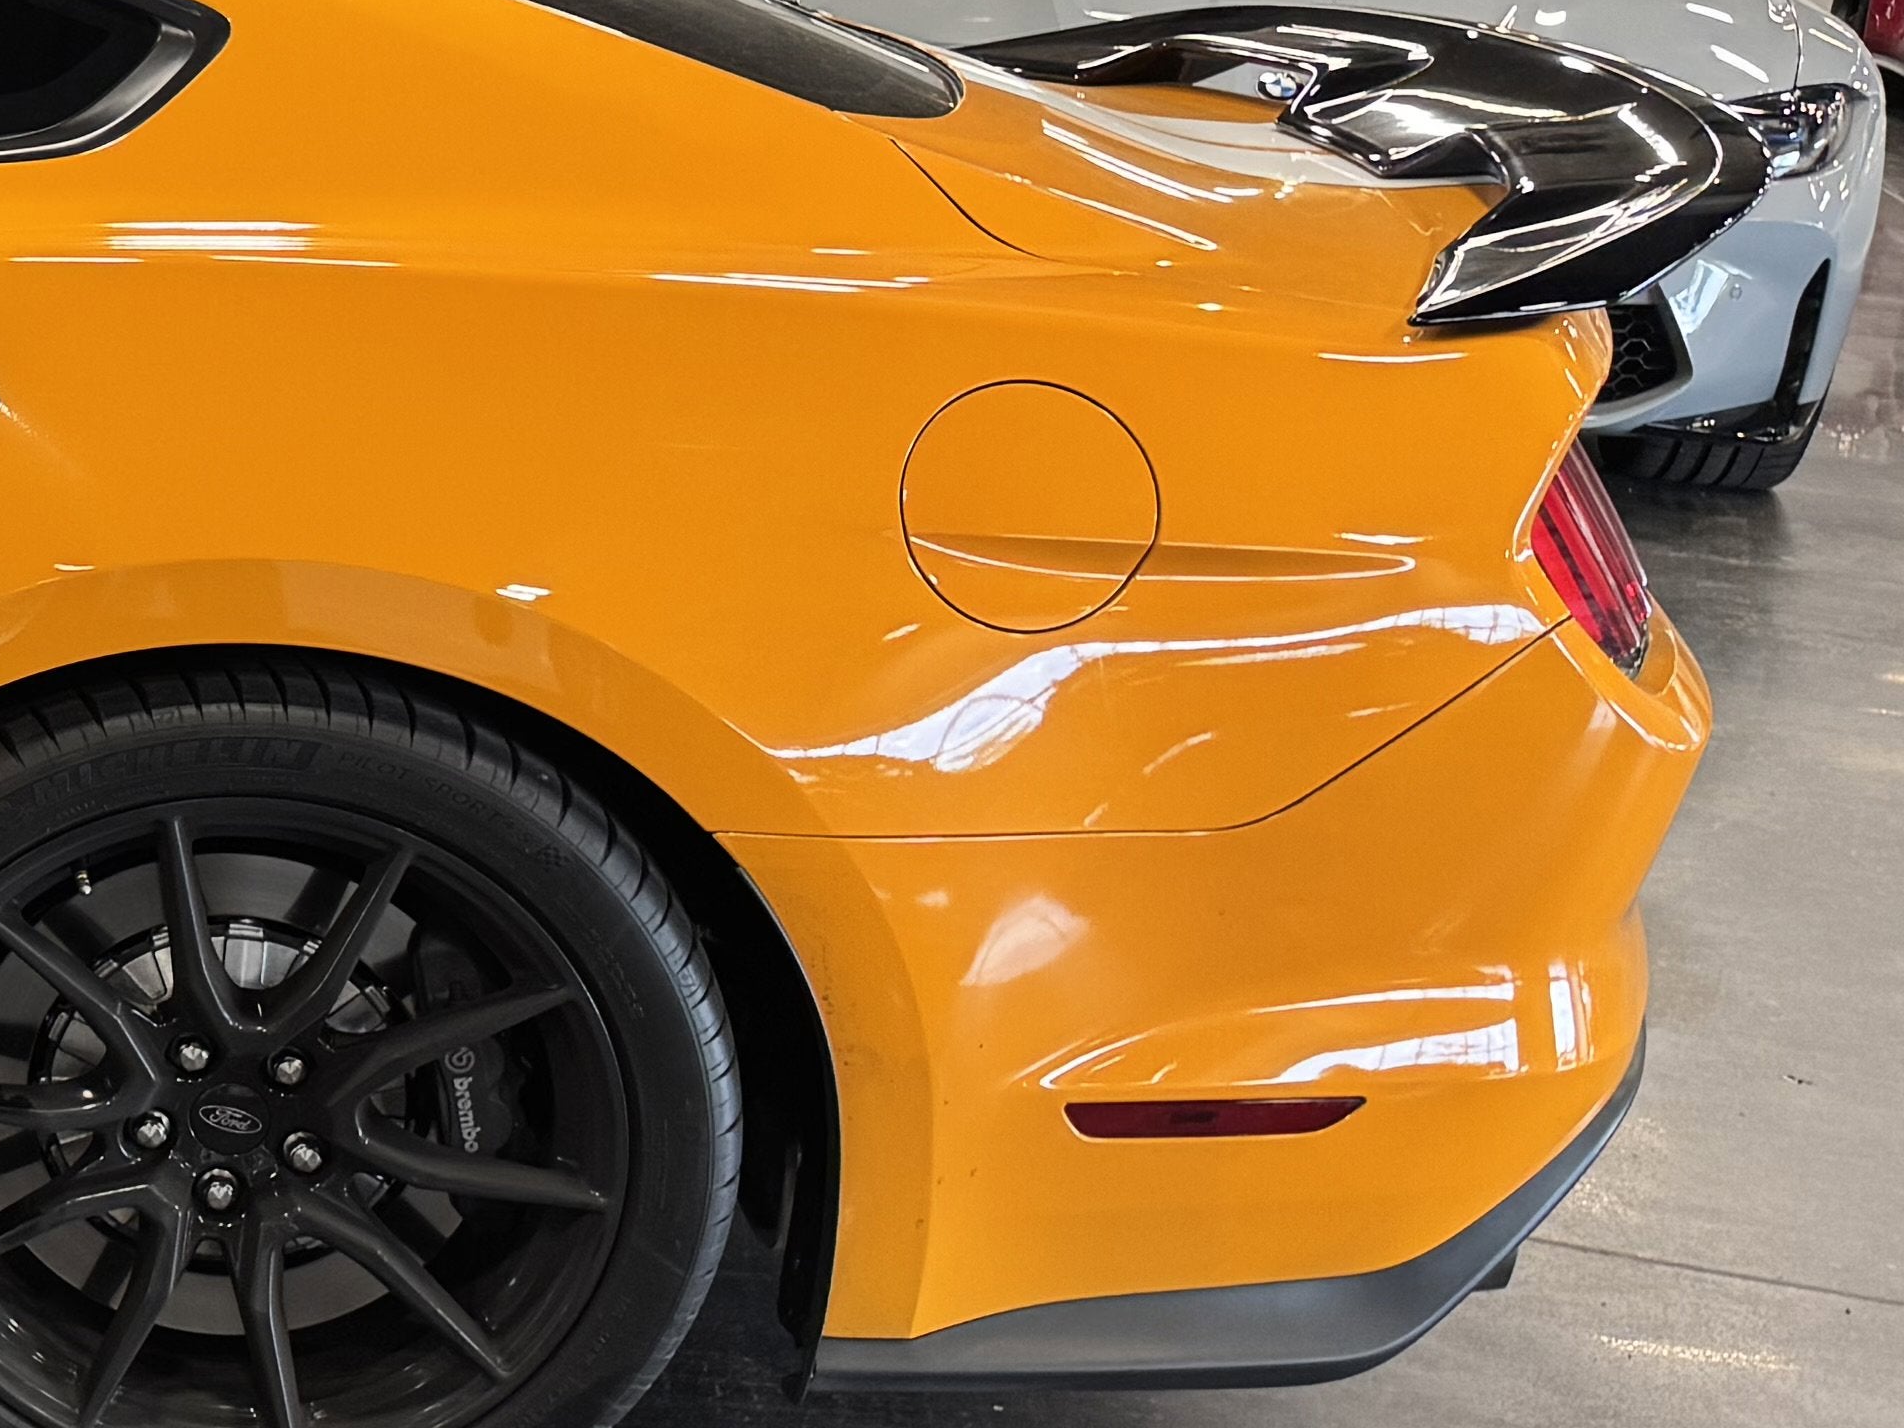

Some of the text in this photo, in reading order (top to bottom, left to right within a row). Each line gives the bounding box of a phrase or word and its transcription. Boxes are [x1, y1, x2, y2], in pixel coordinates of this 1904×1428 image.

[338, 750, 410, 780] PILOT
[424, 775, 504, 822] SPORT
[209, 1107, 251, 1130] Ford
[453, 1076, 481, 1153] brembo
